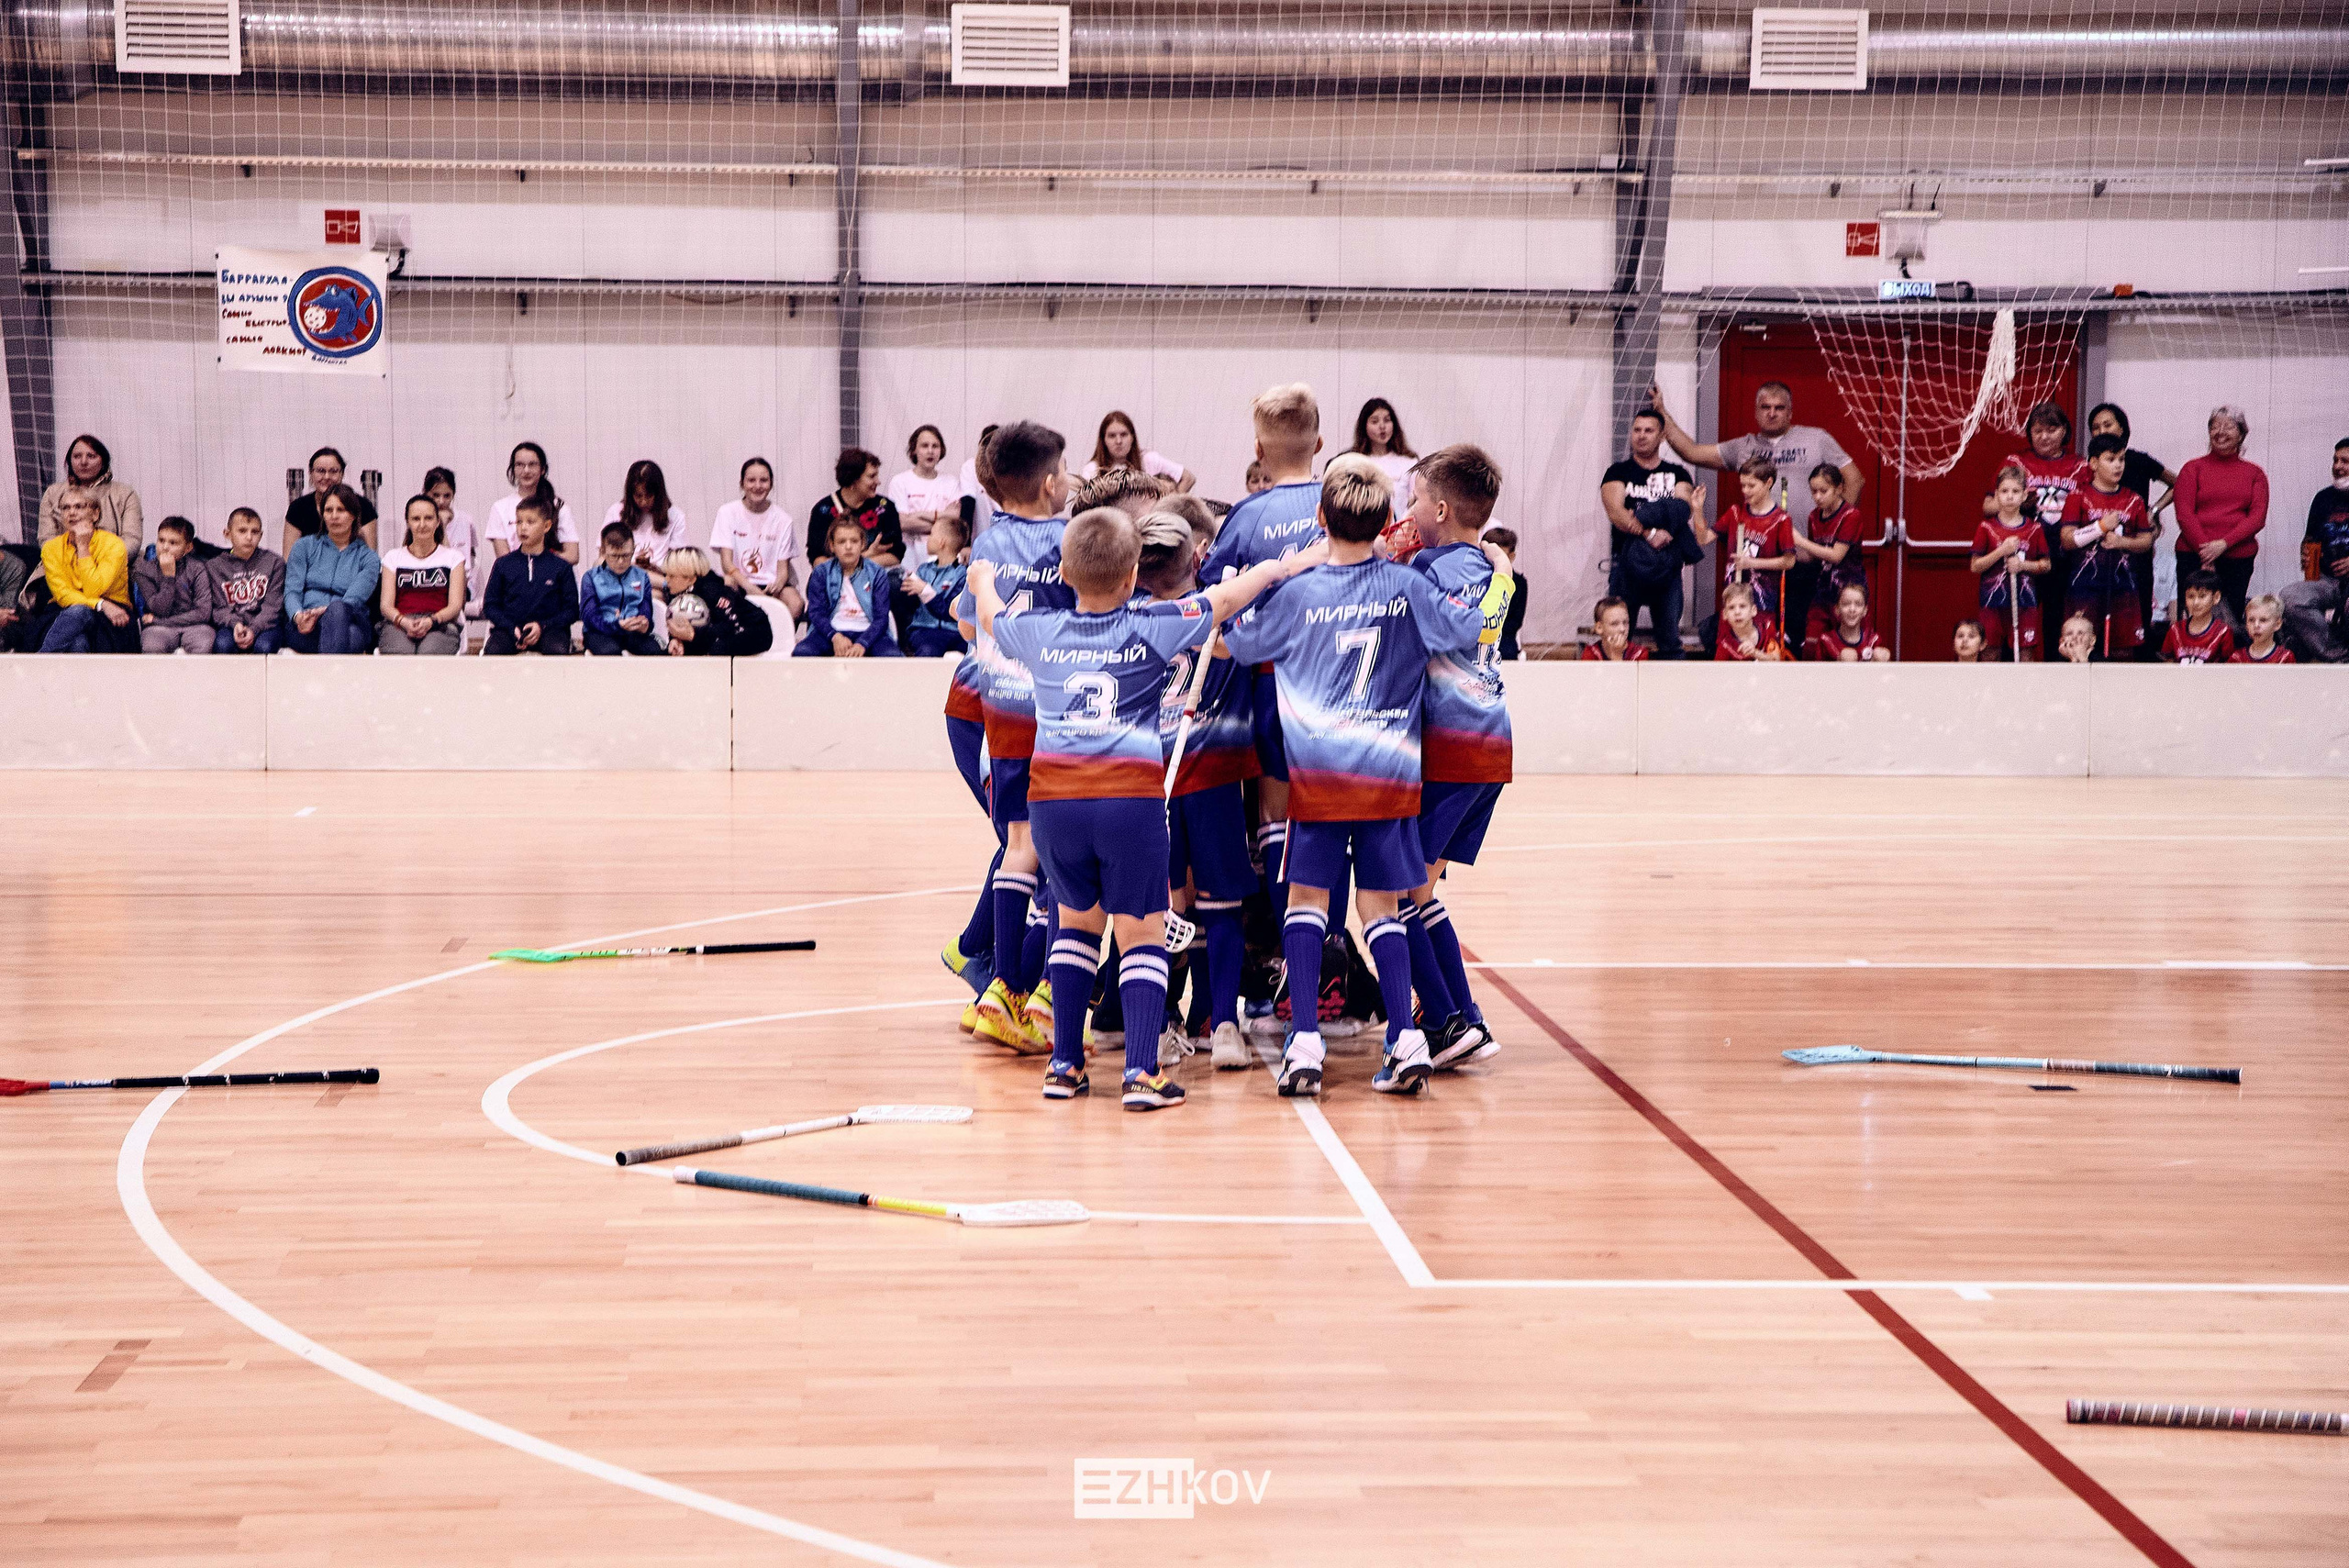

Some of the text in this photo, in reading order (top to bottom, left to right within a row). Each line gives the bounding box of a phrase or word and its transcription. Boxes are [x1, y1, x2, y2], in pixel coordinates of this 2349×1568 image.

[1883, 281, 1932, 297] ВЫХОД
[397, 569, 448, 588] FILA
[992, 562, 1063, 585] ИРНЫЙ
[1305, 595, 1408, 625] МИРНЫЙ
[1040, 642, 1147, 664] МИРНЫЙ
[1335, 626, 1382, 703] 7
[1063, 671, 1119, 722] 3
